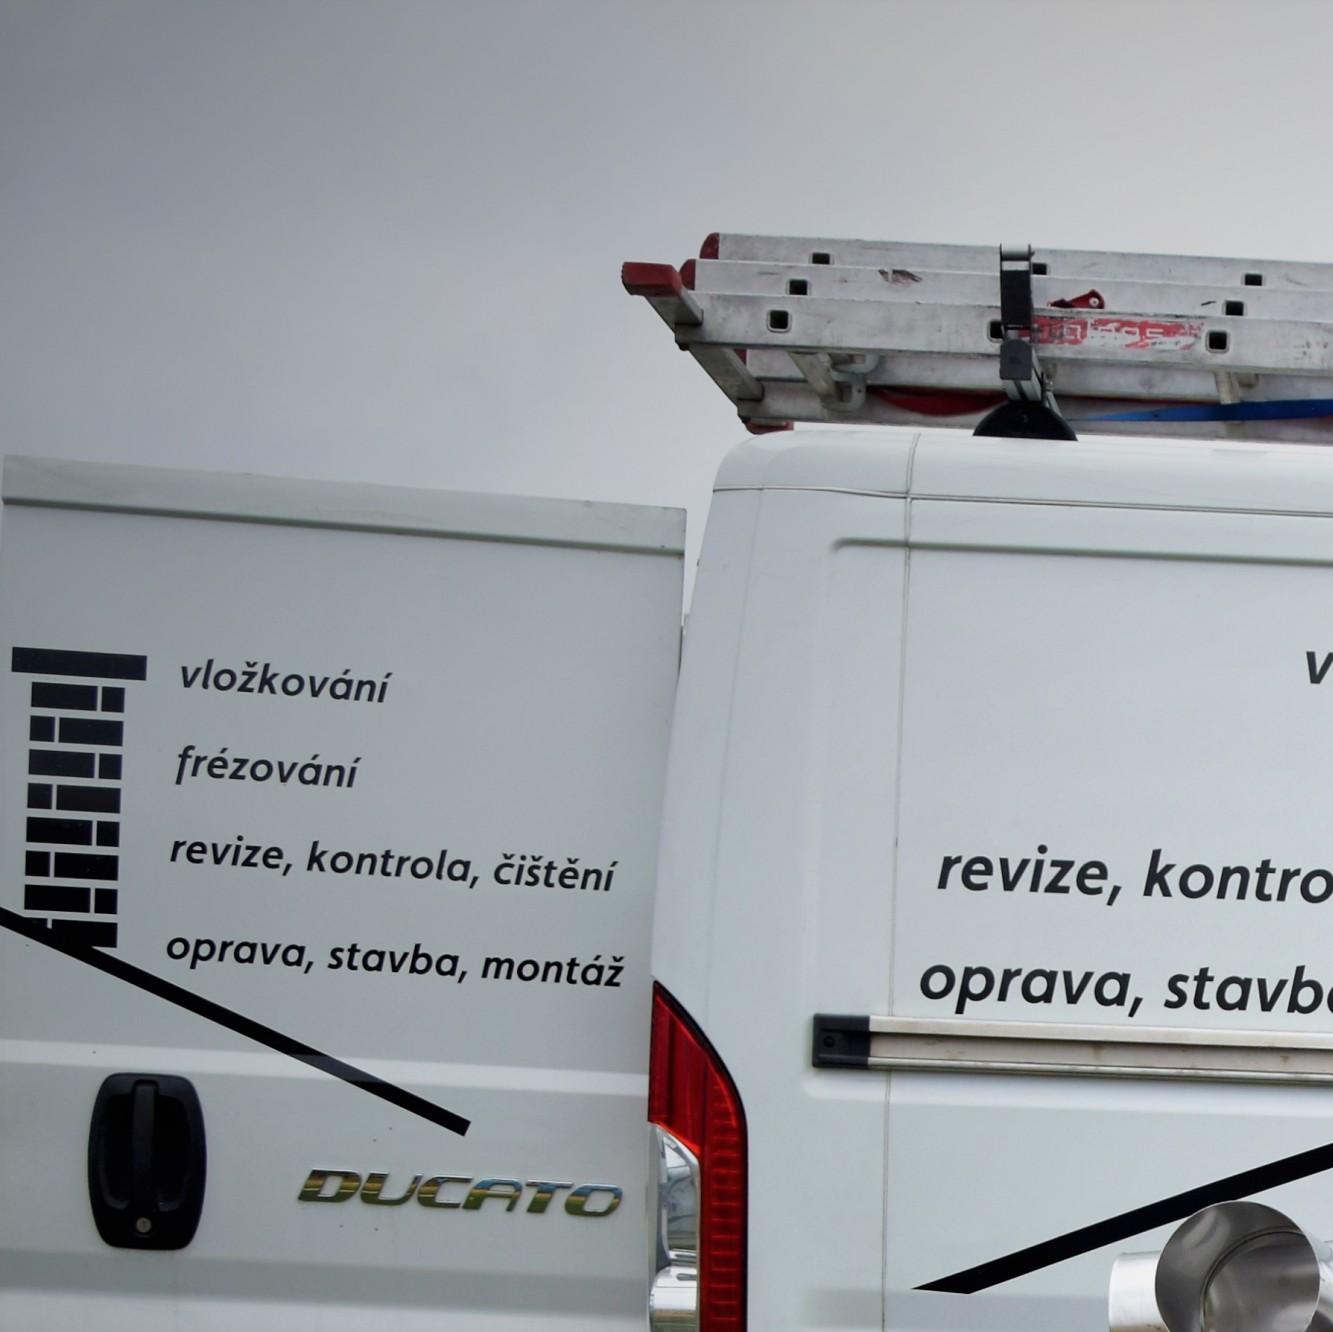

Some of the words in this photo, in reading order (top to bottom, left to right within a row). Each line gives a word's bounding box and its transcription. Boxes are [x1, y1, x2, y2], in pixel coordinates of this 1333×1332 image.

[180, 658, 393, 704] vložkování
[175, 744, 362, 789] frézování
[169, 834, 293, 877] revize,
[306, 840, 479, 889] kontrola,
[493, 852, 619, 892] čištění
[937, 844, 1122, 907] revize,
[166, 936, 314, 975] oprava,
[327, 942, 468, 985] stavba,
[480, 954, 625, 988] montáž
[919, 964, 1144, 1018] oprava,
[298, 1168, 624, 1218] DUCATO
